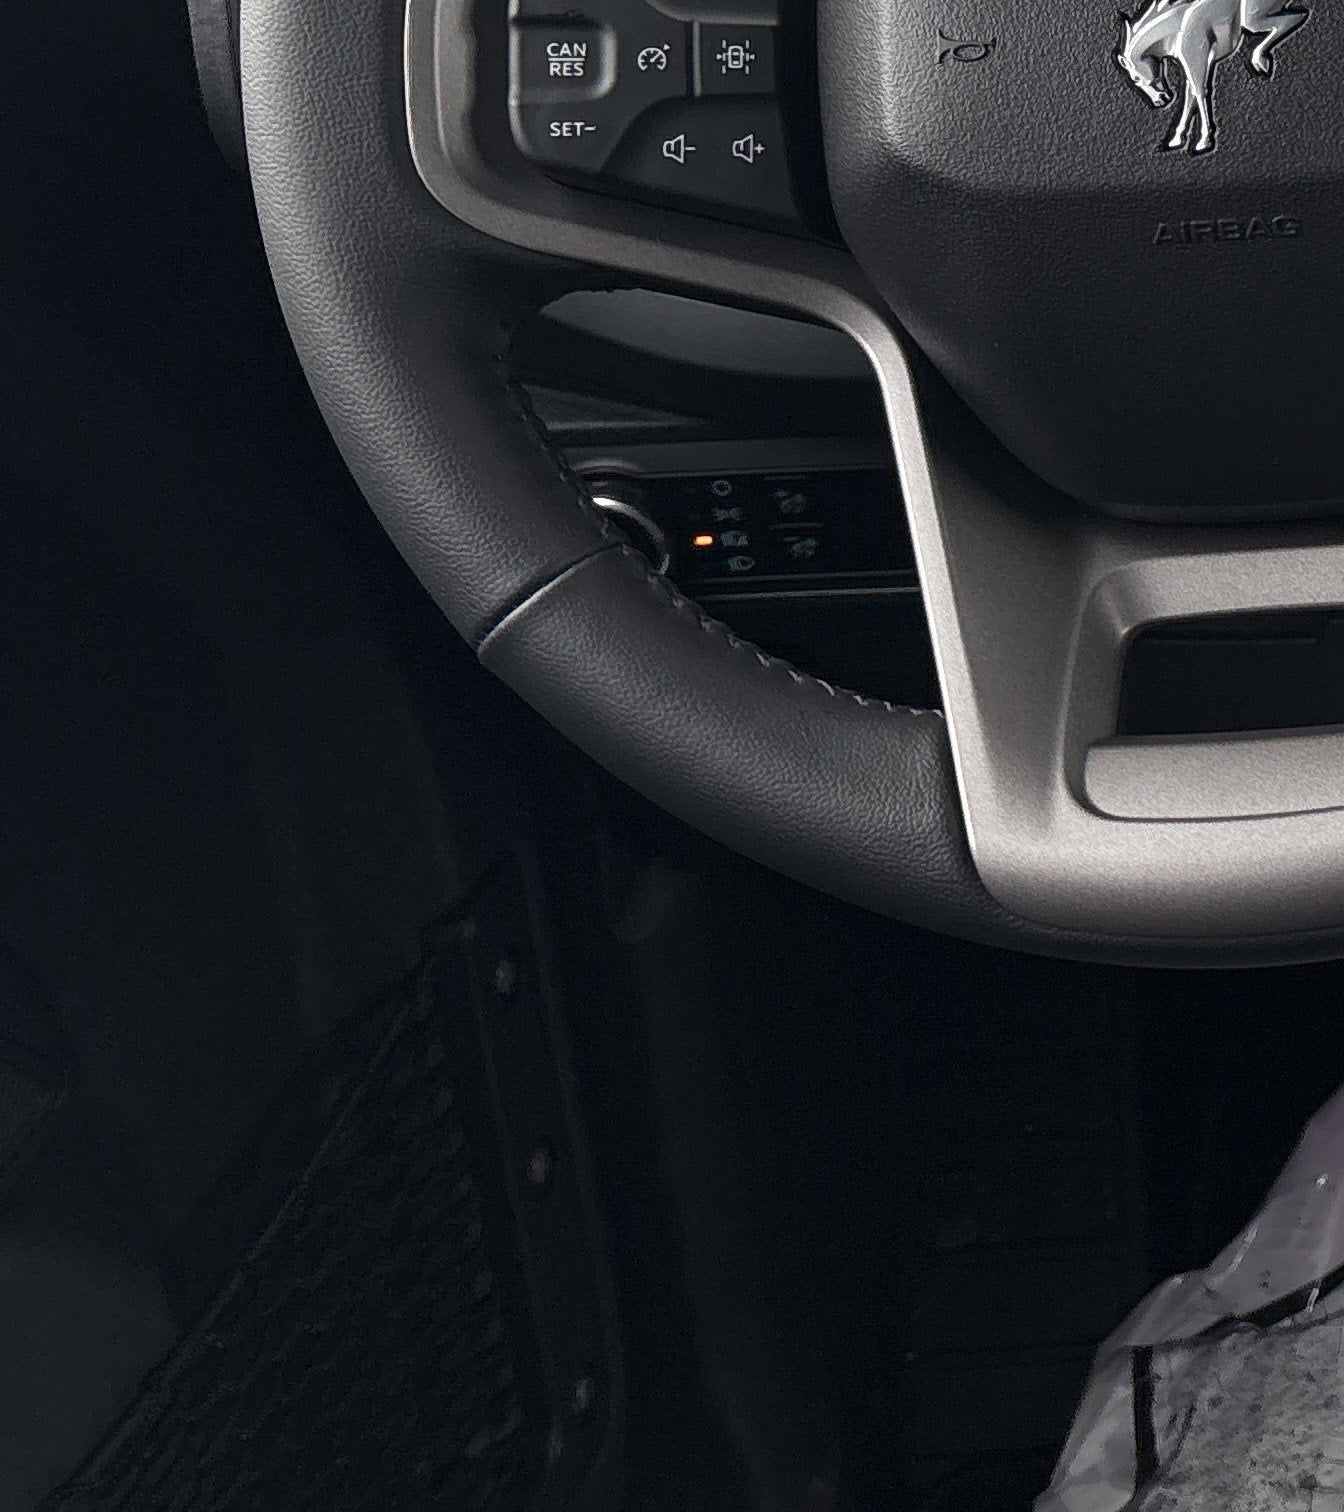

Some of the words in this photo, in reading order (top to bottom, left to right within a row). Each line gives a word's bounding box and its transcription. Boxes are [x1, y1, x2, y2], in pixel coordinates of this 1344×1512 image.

[546, 43, 587, 57] CAN
[549, 62, 584, 77] RES
[549, 121, 596, 137] SET-
[1153, 214, 1301, 245] AIRBAG
